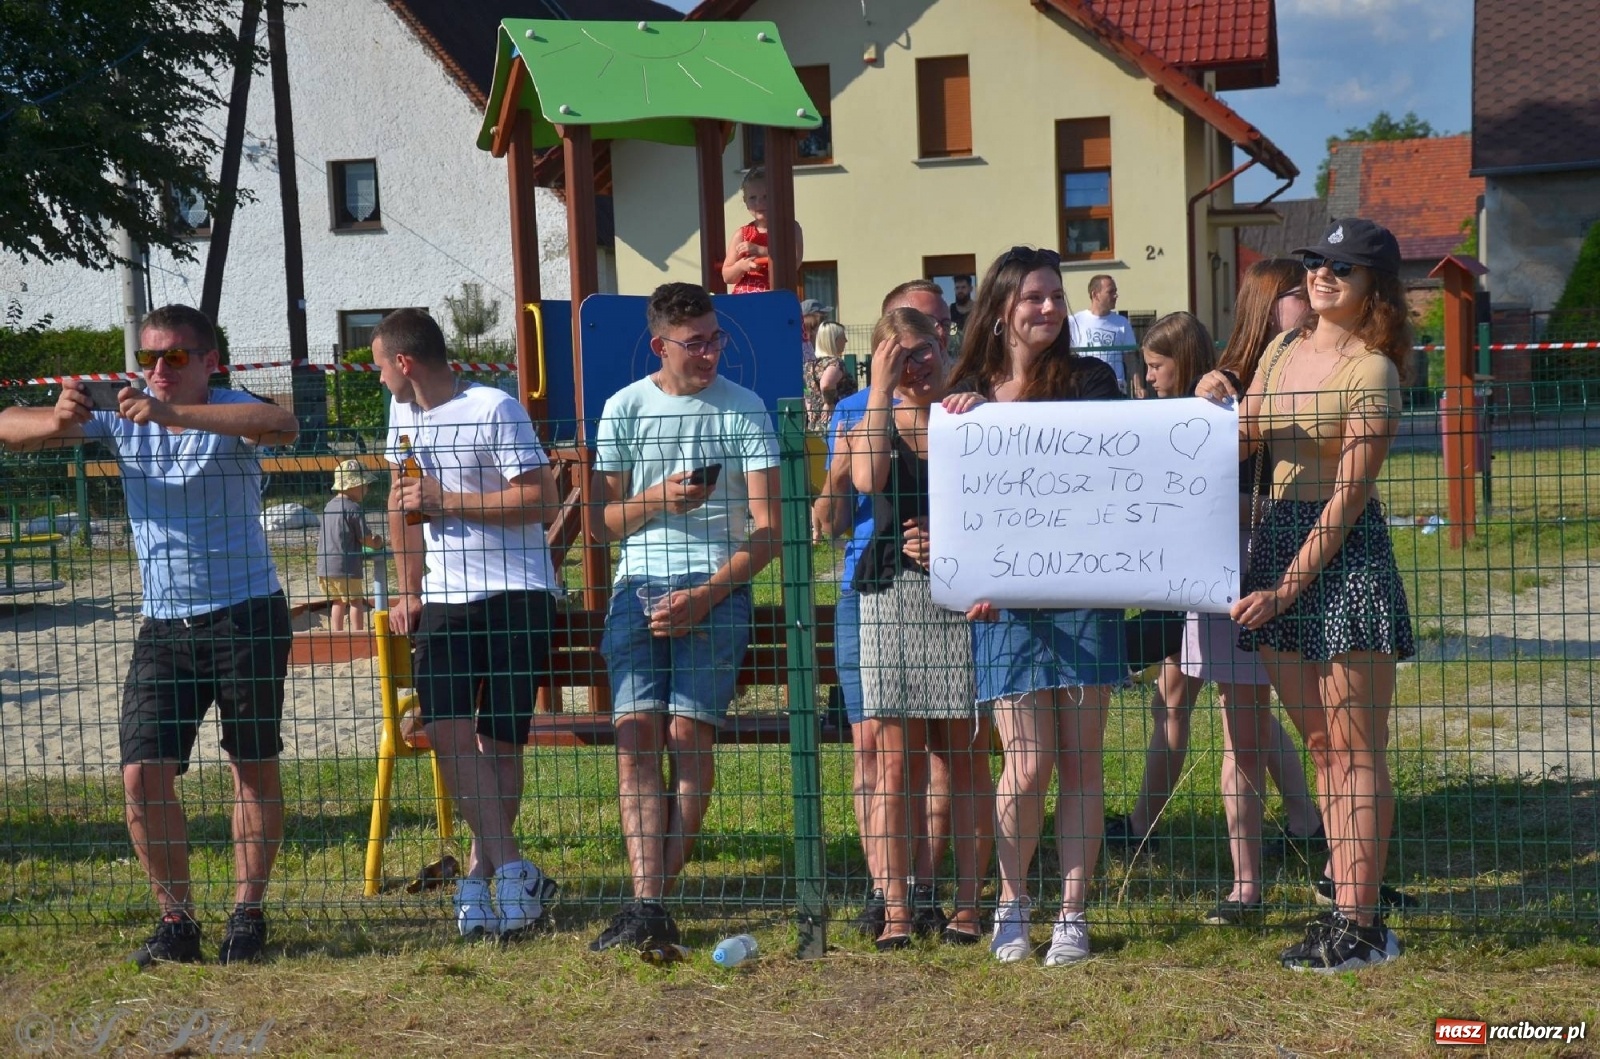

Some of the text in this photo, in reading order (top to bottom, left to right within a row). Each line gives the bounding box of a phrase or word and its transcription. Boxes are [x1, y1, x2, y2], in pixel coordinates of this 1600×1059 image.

[956, 422, 1140, 457] DOMINICZKO
[962, 466, 1207, 497] WYGROSZ TO BO
[963, 502, 1183, 532] W TOBIE JEST
[990, 544, 1164, 578] ŚLONZOCZKI
